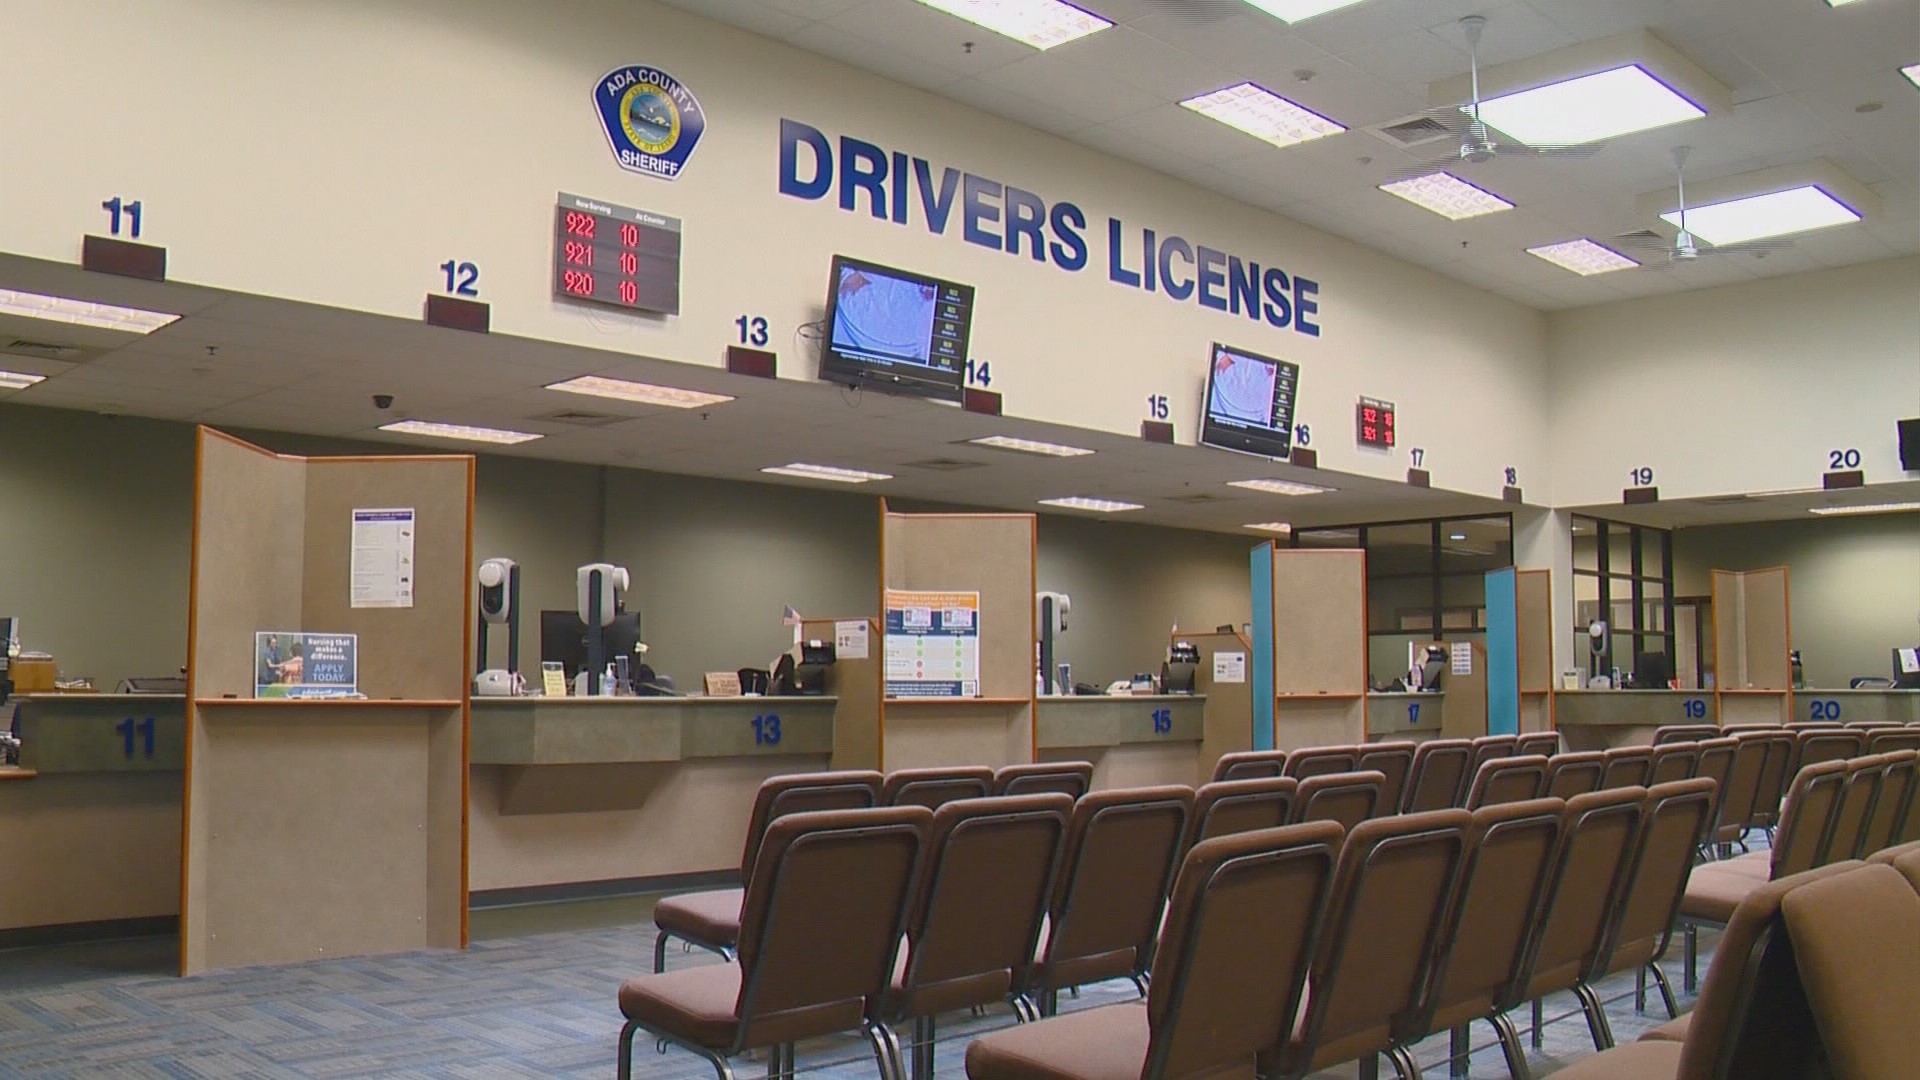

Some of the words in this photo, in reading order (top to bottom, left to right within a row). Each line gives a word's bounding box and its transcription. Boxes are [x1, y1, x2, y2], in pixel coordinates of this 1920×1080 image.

[607, 70, 636, 97] ADA
[638, 69, 695, 113] COUNTY
[621, 149, 679, 175] SHERIFF
[102, 197, 141, 238] 11
[575, 199, 589, 209] Now
[590, 202, 612, 215] Serving
[567, 211, 595, 239] 922
[621, 224, 639, 247] 10
[779, 118, 1088, 271] DRIVERS
[1109, 217, 1319, 337] LICENSE
[565, 240, 593, 267] 921
[620, 252, 637, 276] 10
[440, 260, 479, 297] 12
[565, 269, 593, 296] 920
[619, 280, 637, 303] 10
[735, 315, 768, 347] 13
[966, 359, 991, 387] 14
[1148, 394, 1169, 419] 15
[1294, 423, 1310, 446] 16
[1410, 447, 1424, 467] 17
[1829, 448, 1861, 469] 20
[1504, 467, 1516, 485] 18
[1630, 467, 1653, 486] 19
[308, 637, 334, 647] Nursing
[335, 638, 350, 646] that
[312, 673, 346, 682] TODAY.
[314, 664, 344, 673] APPLY
[1152, 709, 1171, 734] 15
[1408, 703, 1420, 724] 17
[1683, 700, 1706, 719] 19
[1810, 700, 1841, 720] 20
[116, 717, 155, 759] 11
[752, 714, 781, 746] 13
